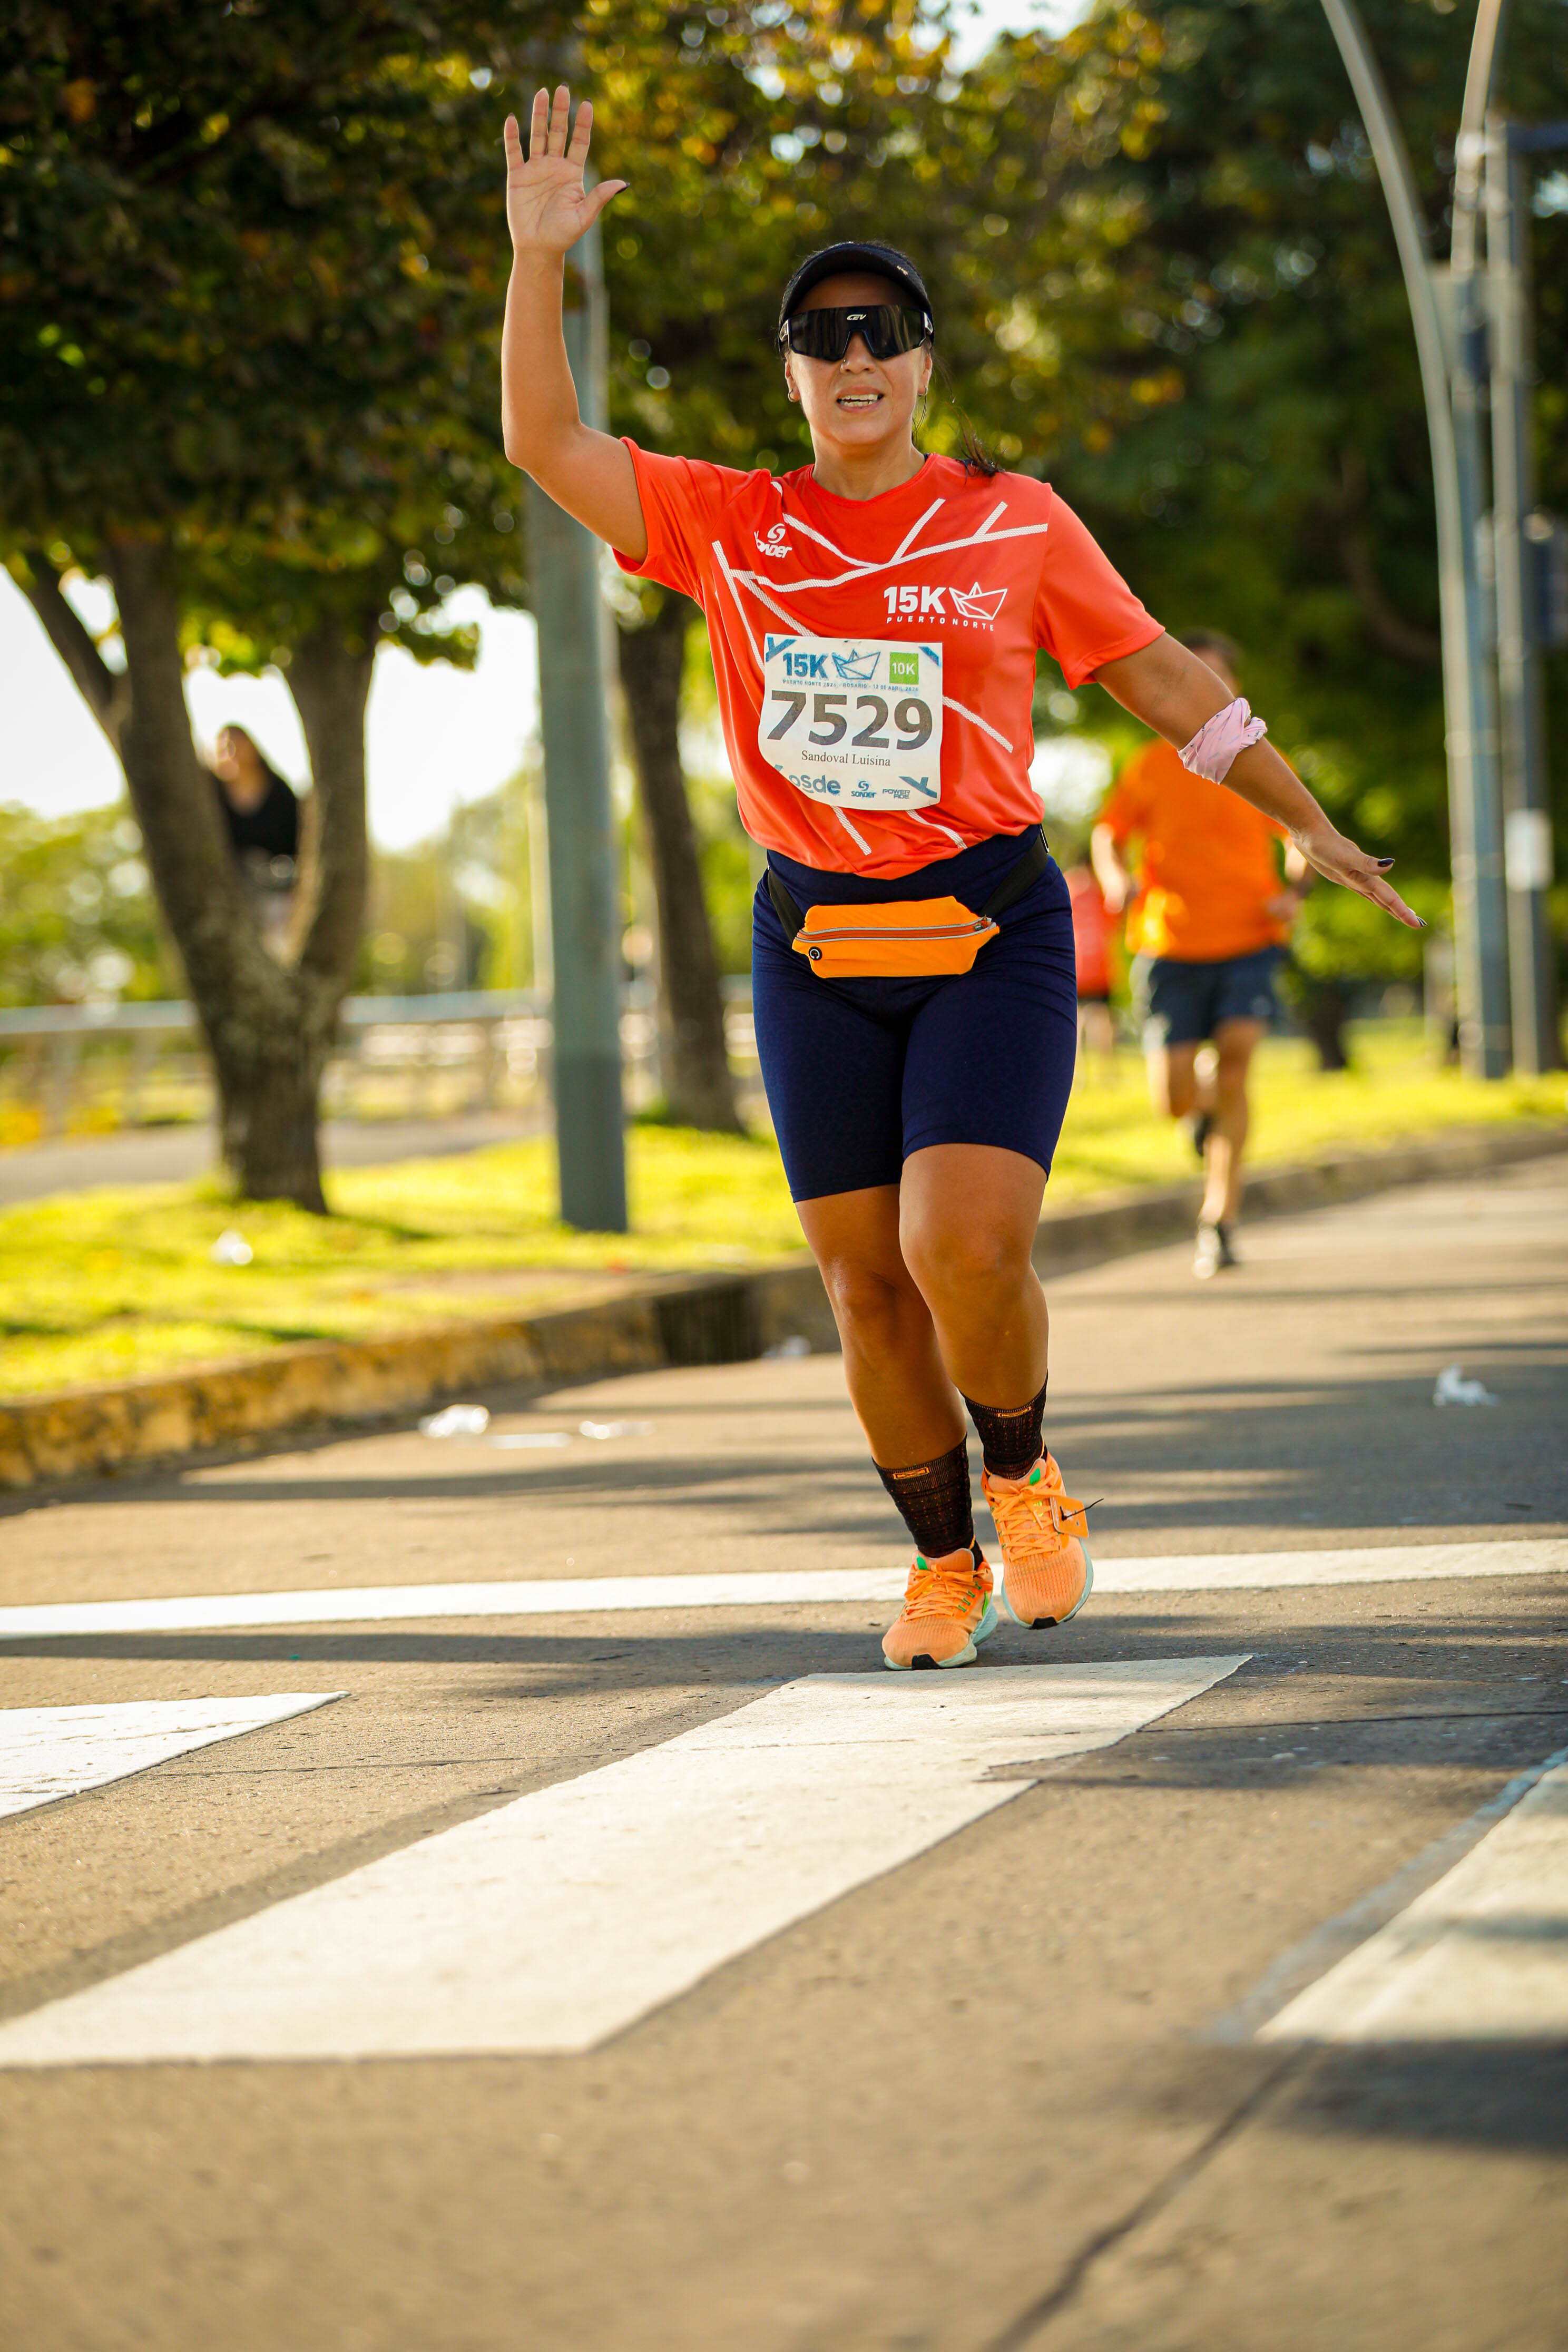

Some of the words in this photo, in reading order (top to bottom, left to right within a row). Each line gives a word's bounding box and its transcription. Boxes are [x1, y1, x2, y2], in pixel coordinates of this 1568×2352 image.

[884, 586, 946, 614] 15K
[886, 615, 946, 624] PUERTO
[952, 618, 994, 631] NORTE
[782, 653, 828, 679] 15K
[891, 661, 916, 675] 10K
[767, 690, 933, 750] 7529
[801, 750, 848, 763] Sandoval
[851, 753, 891, 767] Luisina
[789, 774, 841, 795] osde
